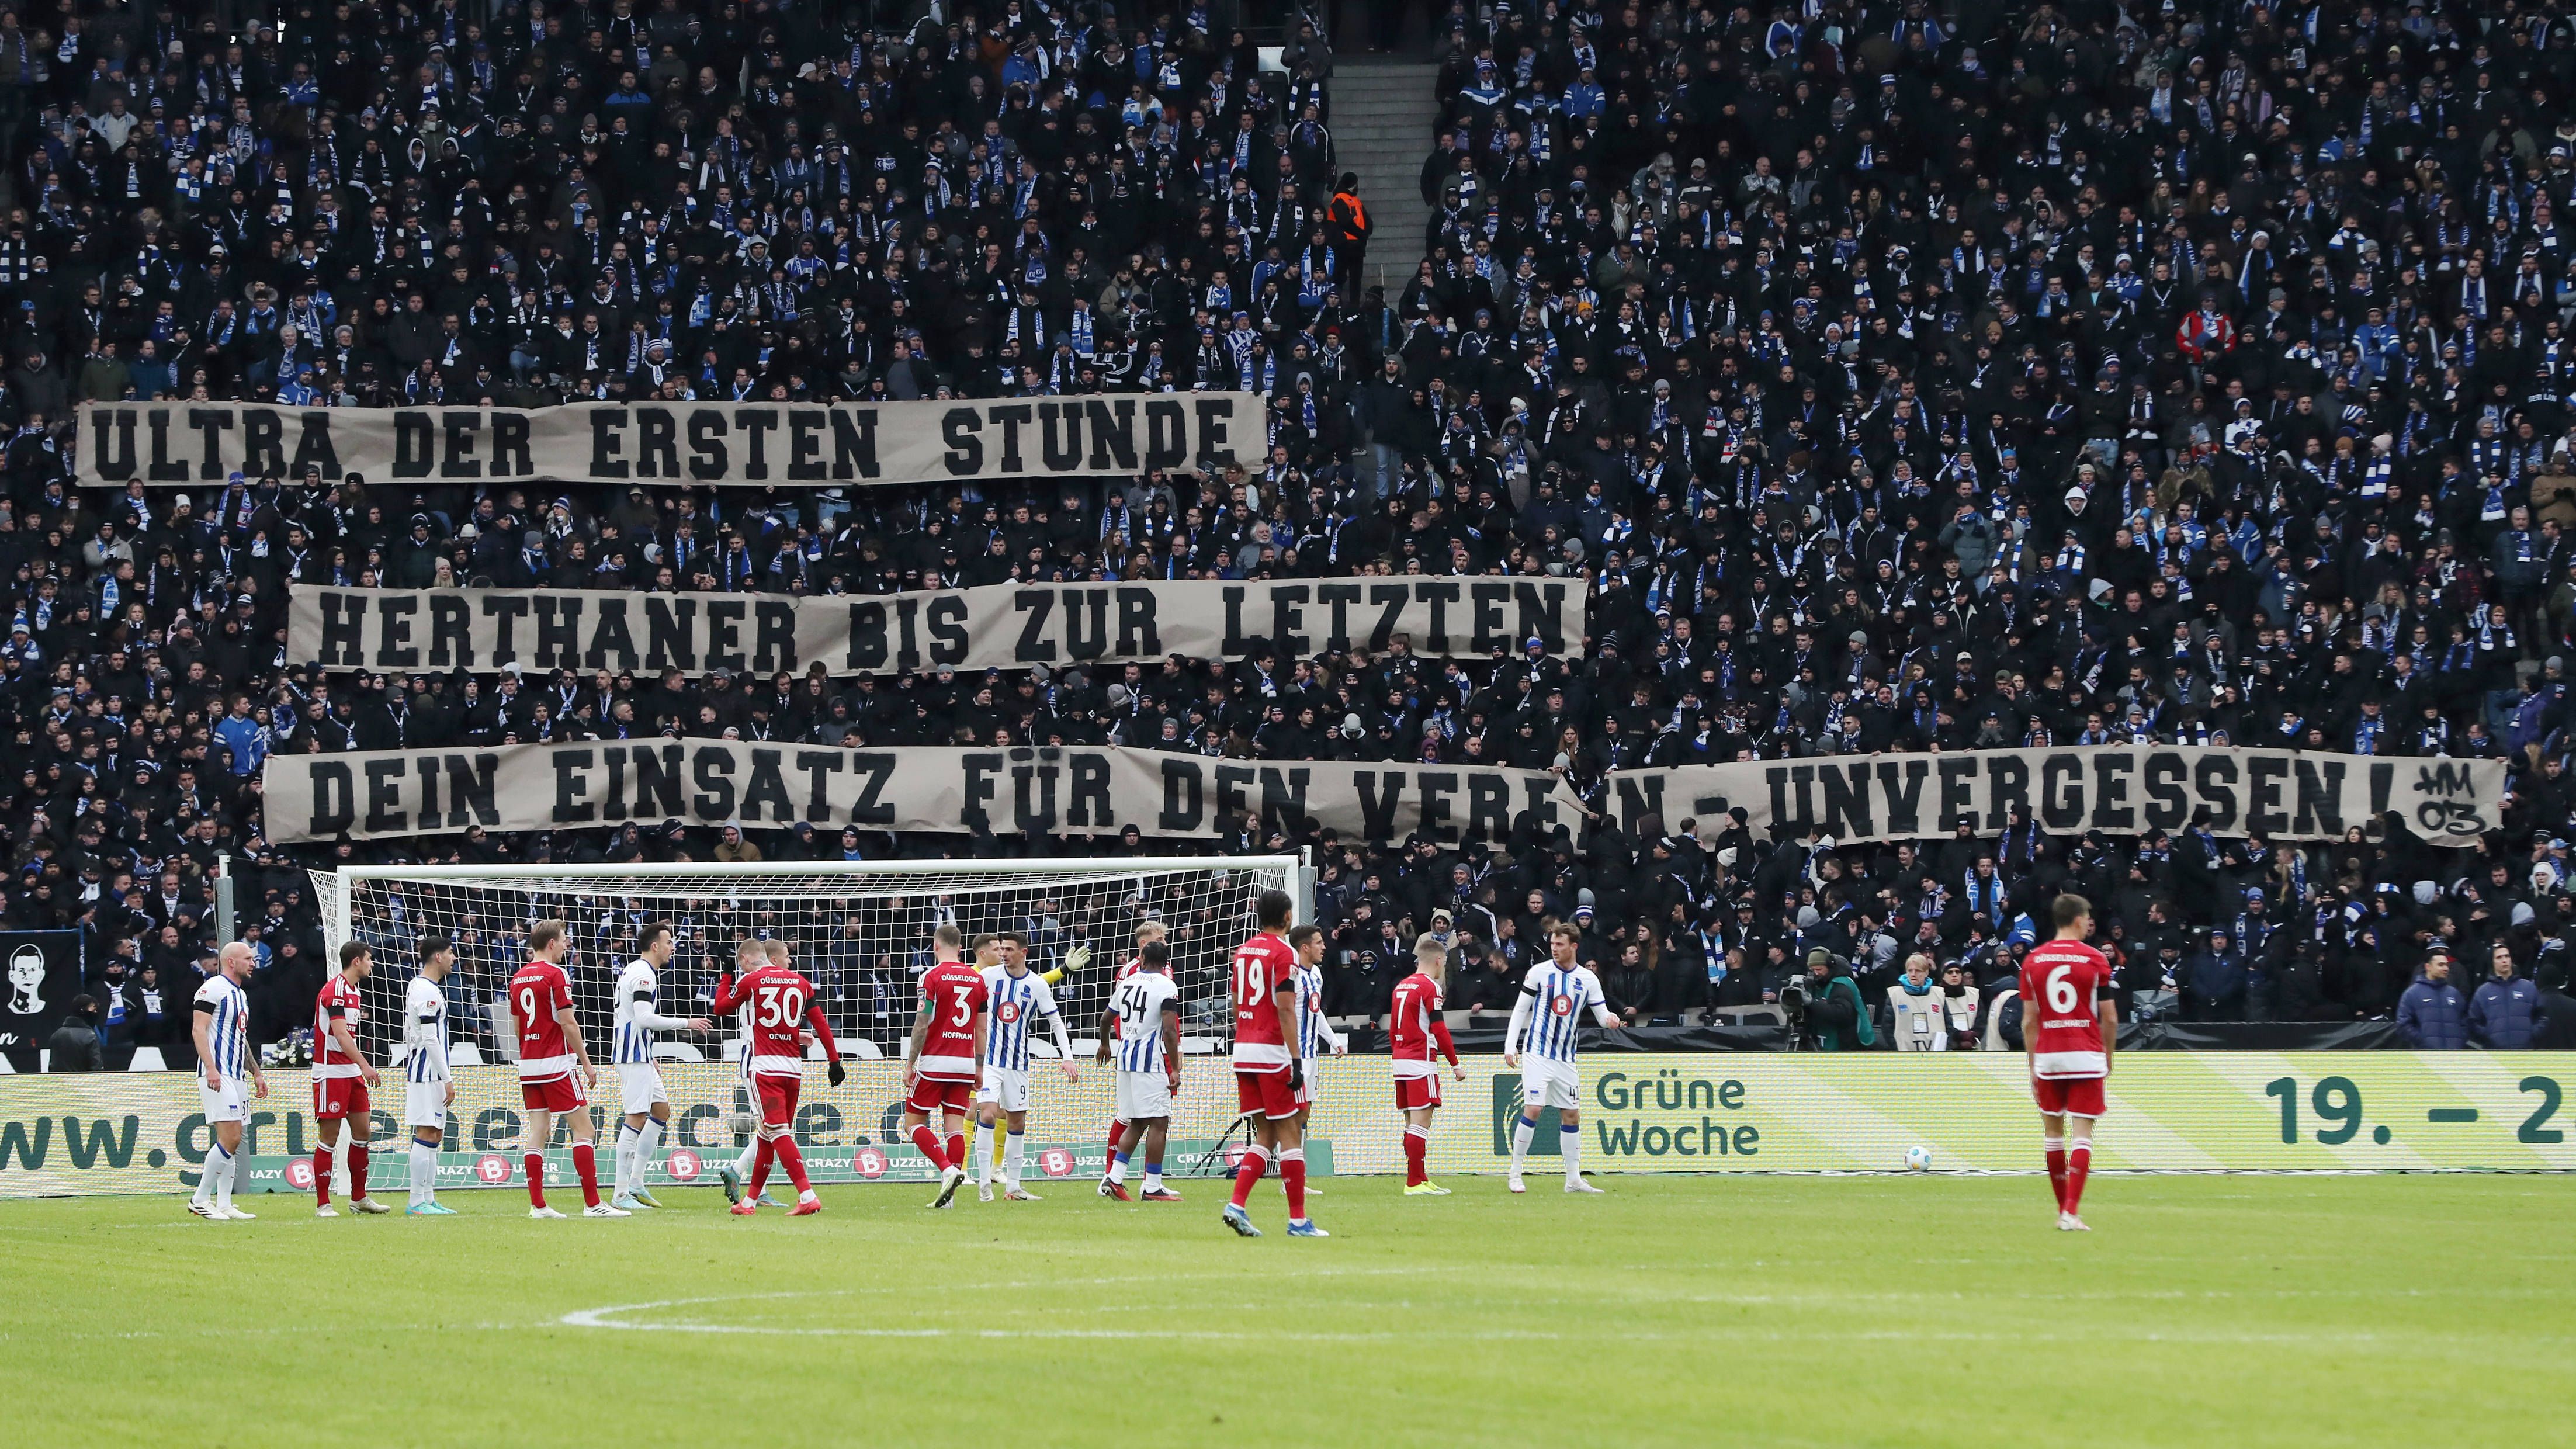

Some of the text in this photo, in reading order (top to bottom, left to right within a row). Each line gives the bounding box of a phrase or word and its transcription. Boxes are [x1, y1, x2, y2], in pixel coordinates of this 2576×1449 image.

[94, 399, 1236, 481] ULTRA DER ERSTEN STUNDE
[319, 581, 1565, 674] HERTHANER BIS ZUR LETZTEN
[309, 751, 501, 834] DEIN
[552, 744, 896, 824] EINSATZ
[961, 747, 1114, 831] FÜR
[1158, 758, 1310, 838] DEN
[2416, 800, 2487, 836] 03
[2033, 953, 2091, 963] DÜSSELDORF
[760, 976, 800, 985] DÜSSELDORF
[941, 973, 980, 983] DÜSSELDORF
[1235, 957, 1265, 1006] 19
[2045, 964, 2078, 1014] 6
[519, 987, 536, 1029] 9
[758, 987, 804, 1028] 30
[951, 985, 974, 1028] 3
[1003, 1005, 1014, 1020] B
[1121, 985, 1147, 1024] 34
[1396, 990, 1409, 1029] 7
[1556, 999, 1568, 1013] B
[1912, 1040, 1932, 1051] TV
[1020, 1084, 1026, 1100] 9
[1597, 1069, 1745, 1110] Grüne
[2265, 1076, 2393, 1145] 19.
[1596, 1116, 1760, 1156] Woche
[249, 1169, 283, 1180] RAZY
[436, 1165, 474, 1176] RAZY
[806, 1157, 852, 1168] CRAZY
